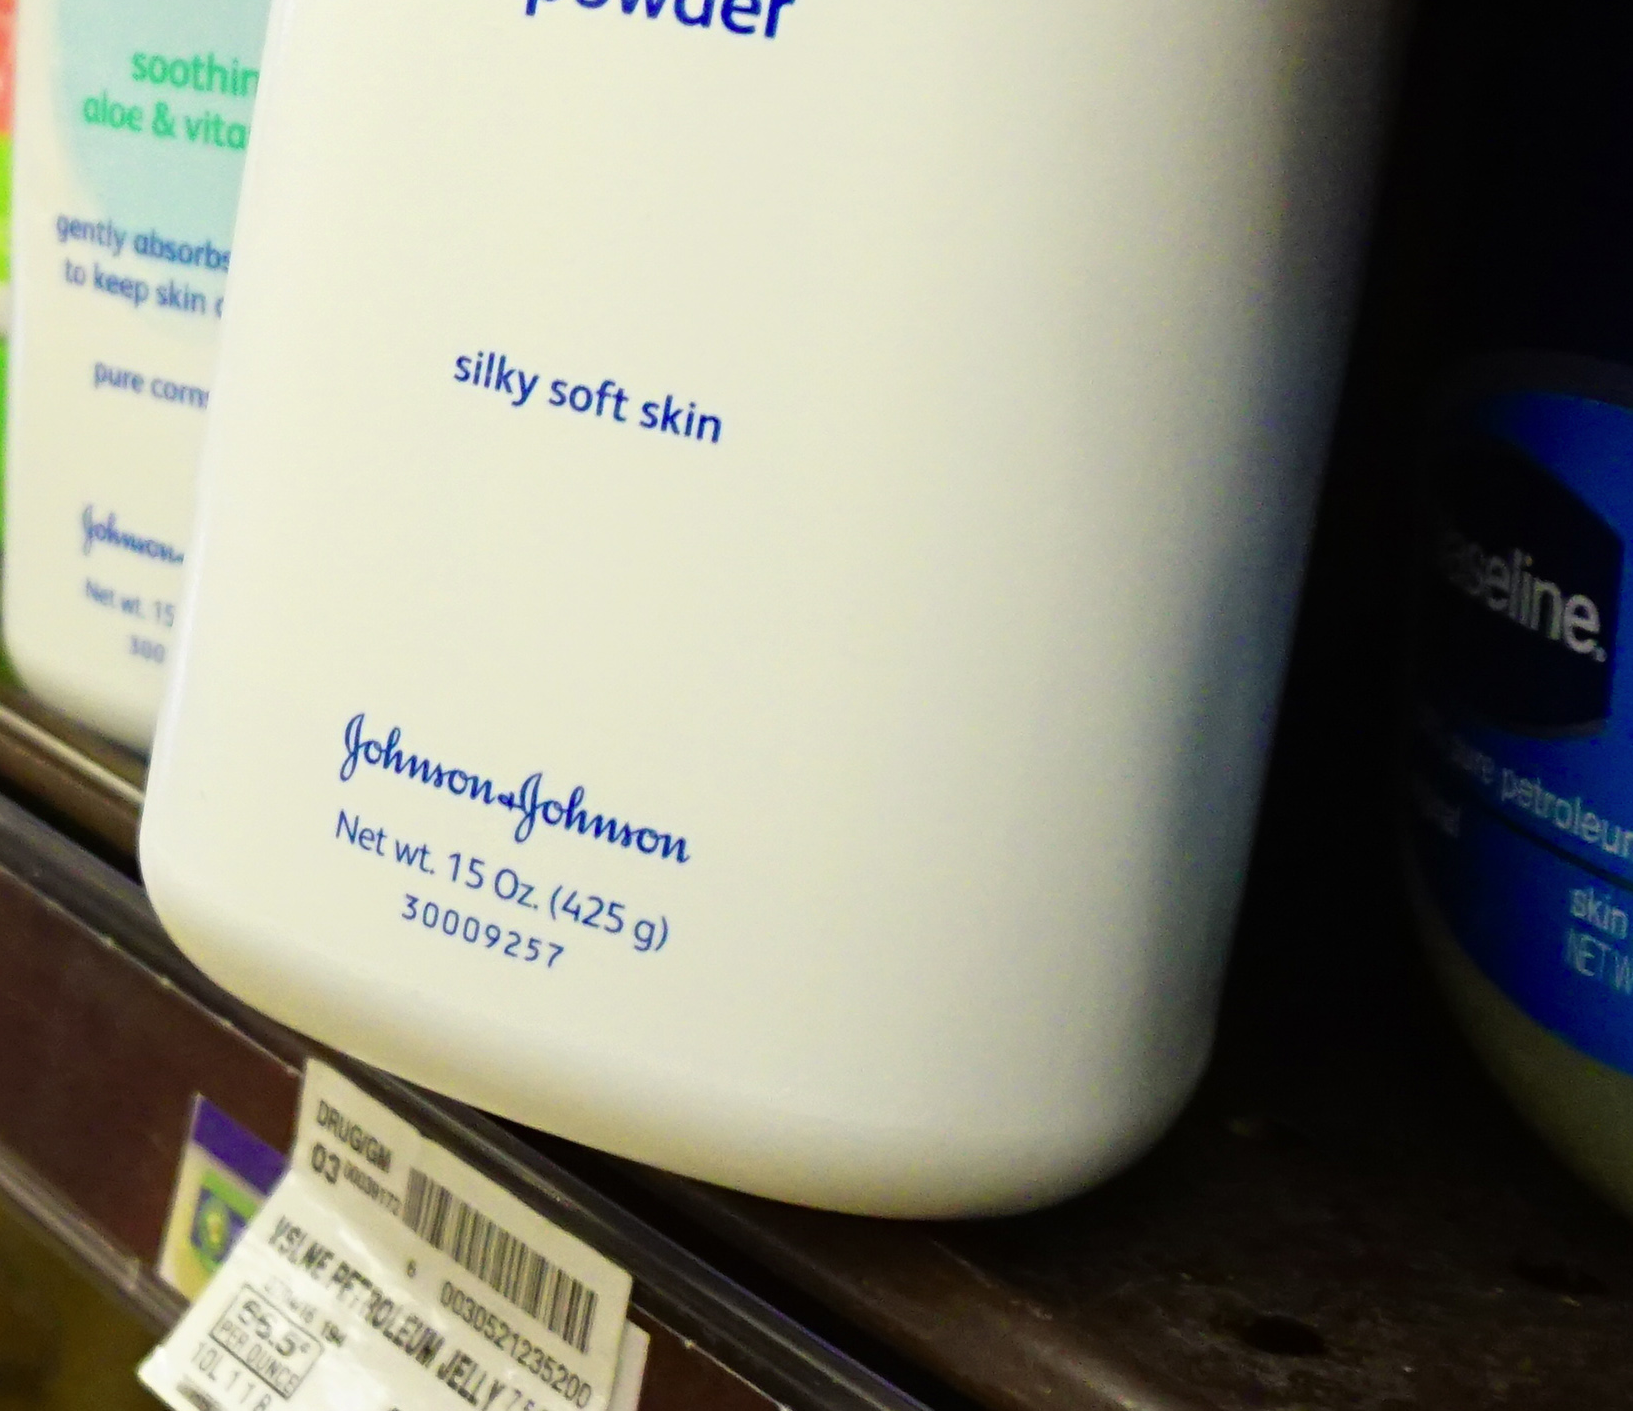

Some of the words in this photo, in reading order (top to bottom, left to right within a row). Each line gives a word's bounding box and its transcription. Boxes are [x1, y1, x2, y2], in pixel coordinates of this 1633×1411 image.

[130, 50, 260, 98] soothin
[82, 89, 144, 132] aloe
[151, 100, 177, 138] &
[184, 110, 251, 152] vita
[56, 213, 126, 257] gently
[65, 257, 86, 287] to
[92, 262, 149, 308] keep
[155, 277, 206, 316] skin
[93, 360, 144, 395] pure
[150, 378, 210, 410] corn
[453, 351, 540, 408] silky
[548, 378, 630, 423] soft
[639, 394, 723, 445] skin
[81, 503, 184, 566] Johnson
[336, 809, 389, 857] Net
[394, 838, 435, 876] wt.
[448, 851, 486, 890] 15
[493, 867, 539, 910] Oz.
[549, 884, 627, 935] (425
[633, 916, 670, 953] g)
[401, 893, 565, 969] 30009257
[1568, 885, 1629, 941] skin
[311, 1140, 342, 1186] 03
[316, 1098, 393, 1175] DRUG/GM
[246, 1343, 301, 1395] OUNCE
[436, 1348, 507, 1411] JELLY
